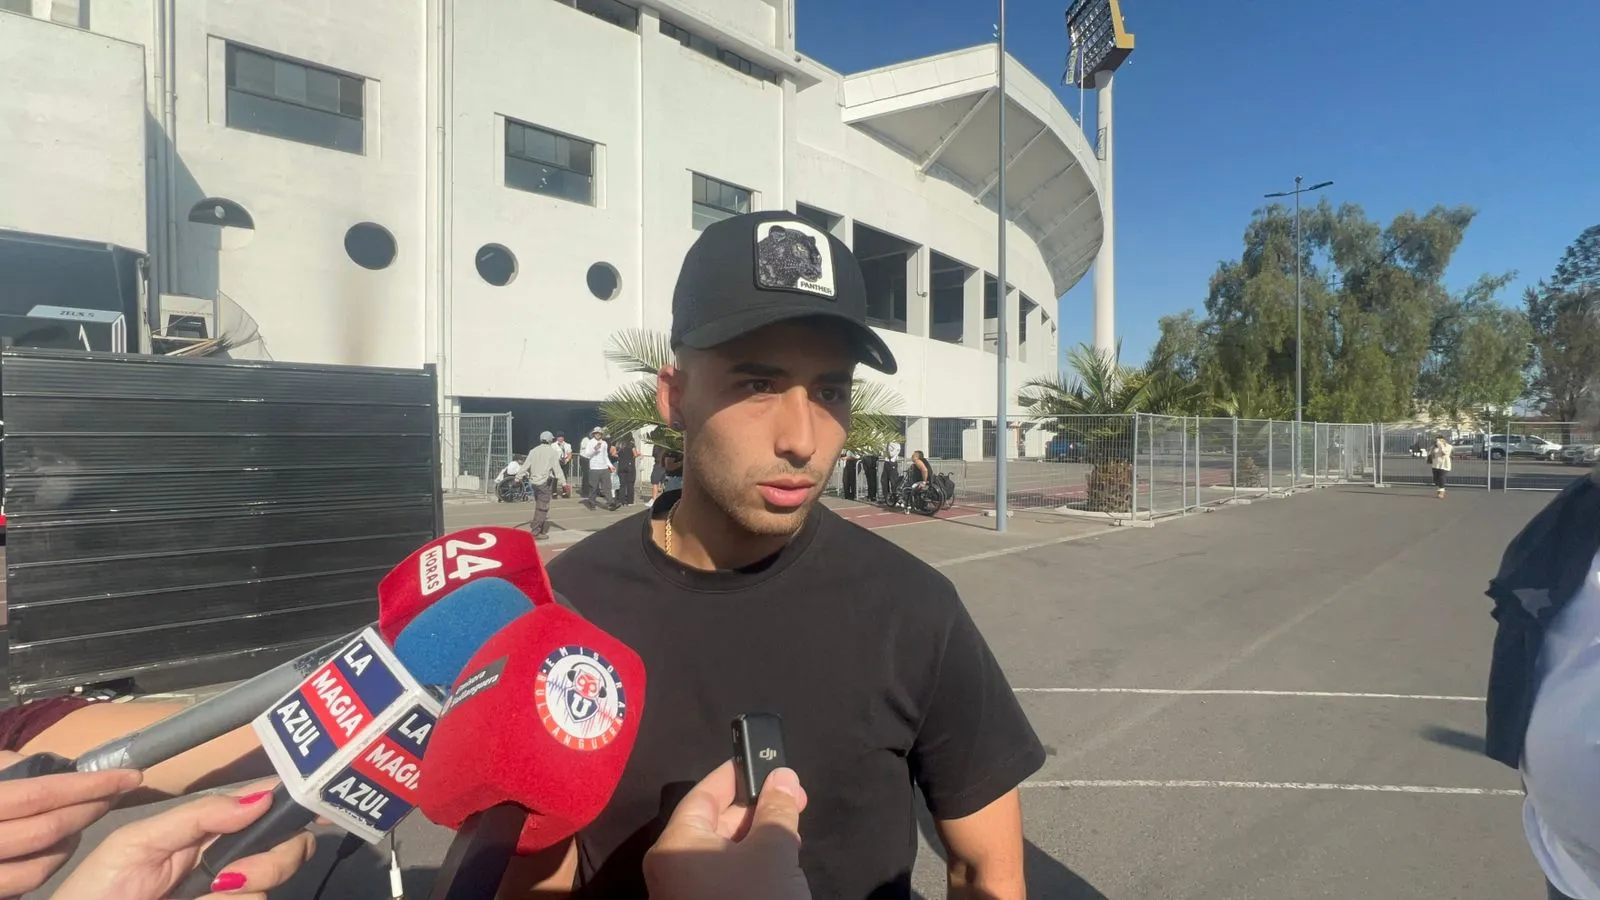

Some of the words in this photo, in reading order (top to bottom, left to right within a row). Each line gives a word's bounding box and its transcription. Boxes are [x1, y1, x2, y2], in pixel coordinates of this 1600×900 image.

[800, 281, 832, 294] PANTHER
[425, 550, 439, 590] HORAS
[445, 532, 502, 579] 24
[343, 643, 373, 676] LA
[545, 647, 626, 708] EMISORA
[311, 669, 363, 737] MAGIA
[571, 693, 592, 717] U
[277, 700, 320, 757] AZUL
[398, 713, 432, 745] LA
[759, 747, 777, 761] dji
[328, 776, 389, 819] AZUL
